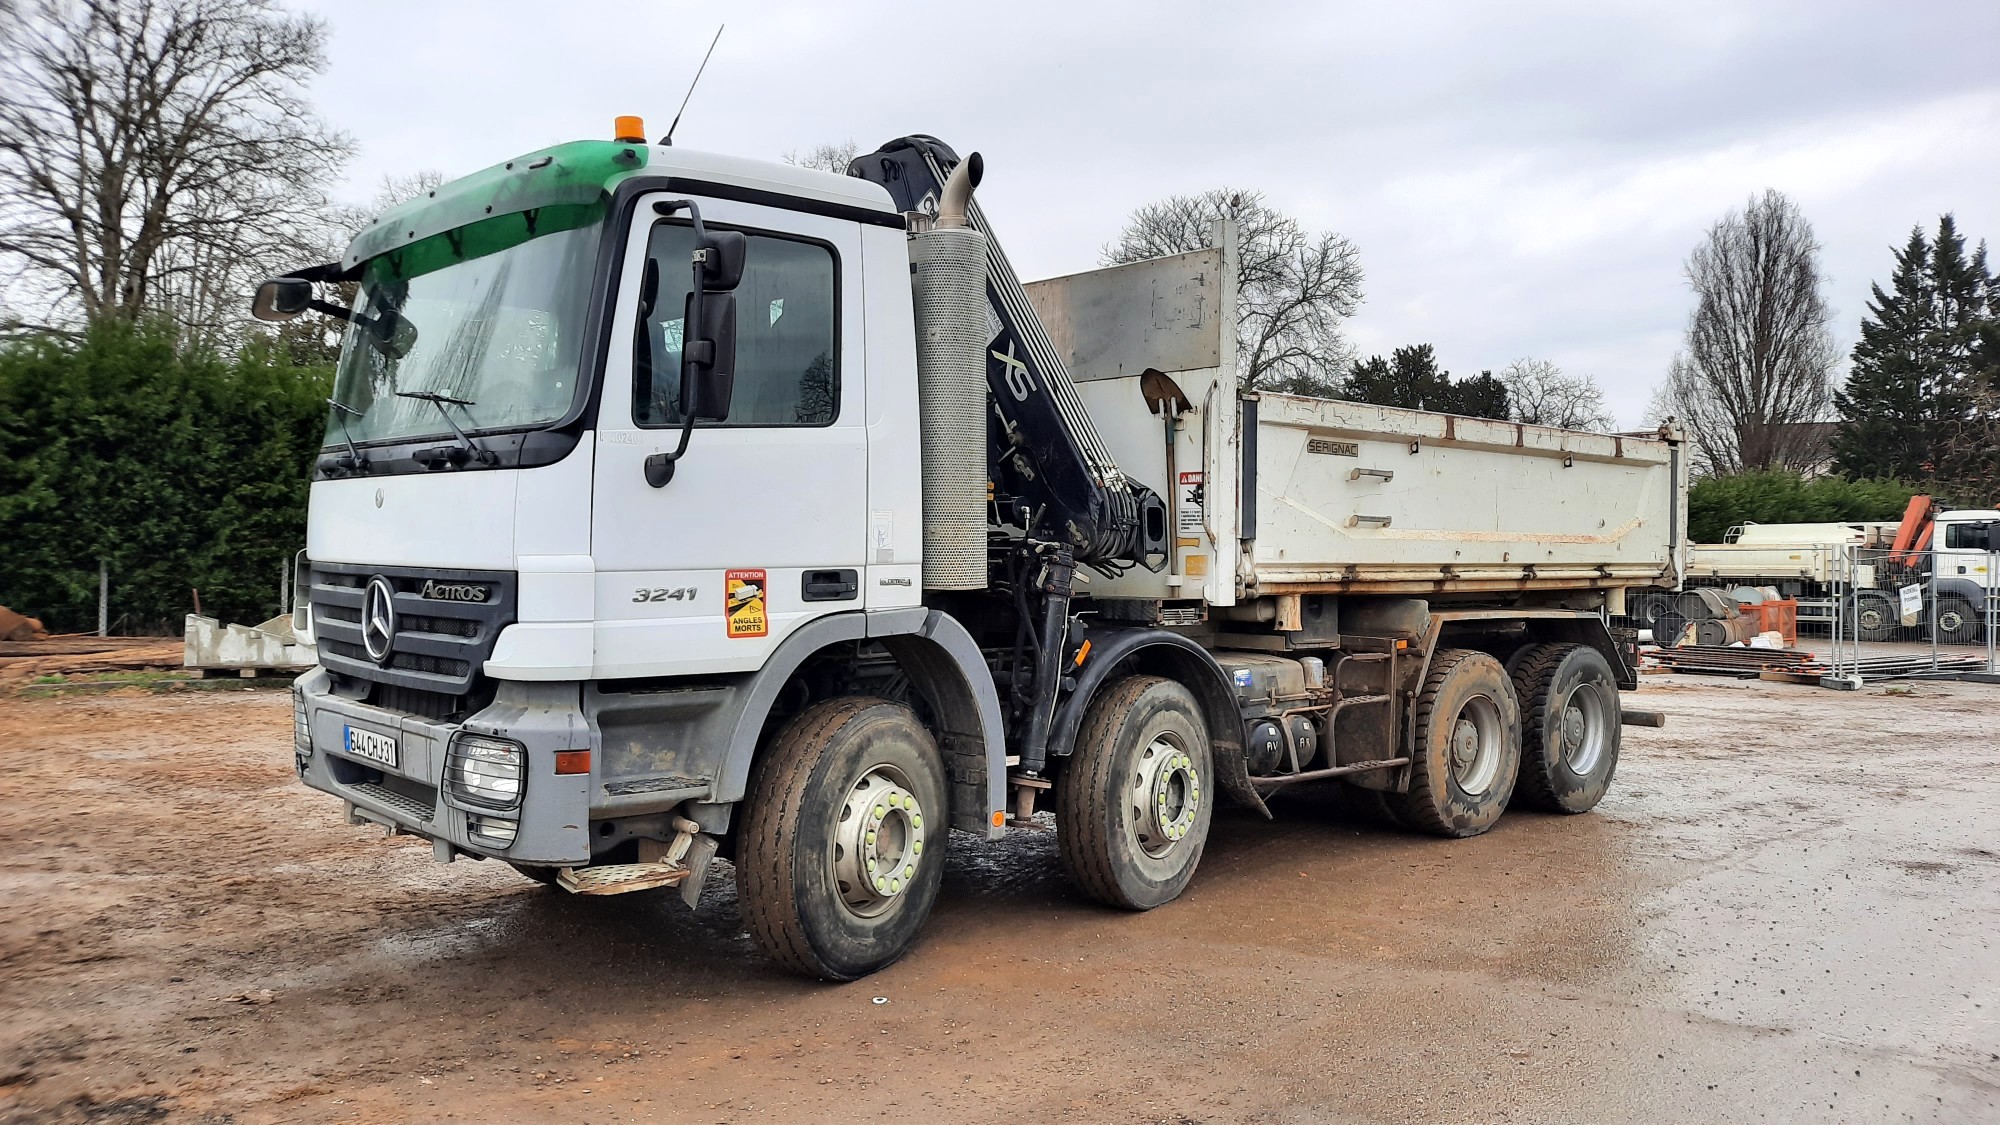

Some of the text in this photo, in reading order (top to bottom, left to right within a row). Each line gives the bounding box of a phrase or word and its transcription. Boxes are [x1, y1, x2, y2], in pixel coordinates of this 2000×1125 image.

[992, 338, 1037, 402] XS
[1309, 441, 1356, 456] SERIGNAC
[728, 571, 764, 579] ATTENTION
[632, 587, 698, 602] 3241
[733, 616, 763, 624] ANGLES
[734, 624, 762, 632] MORTS
